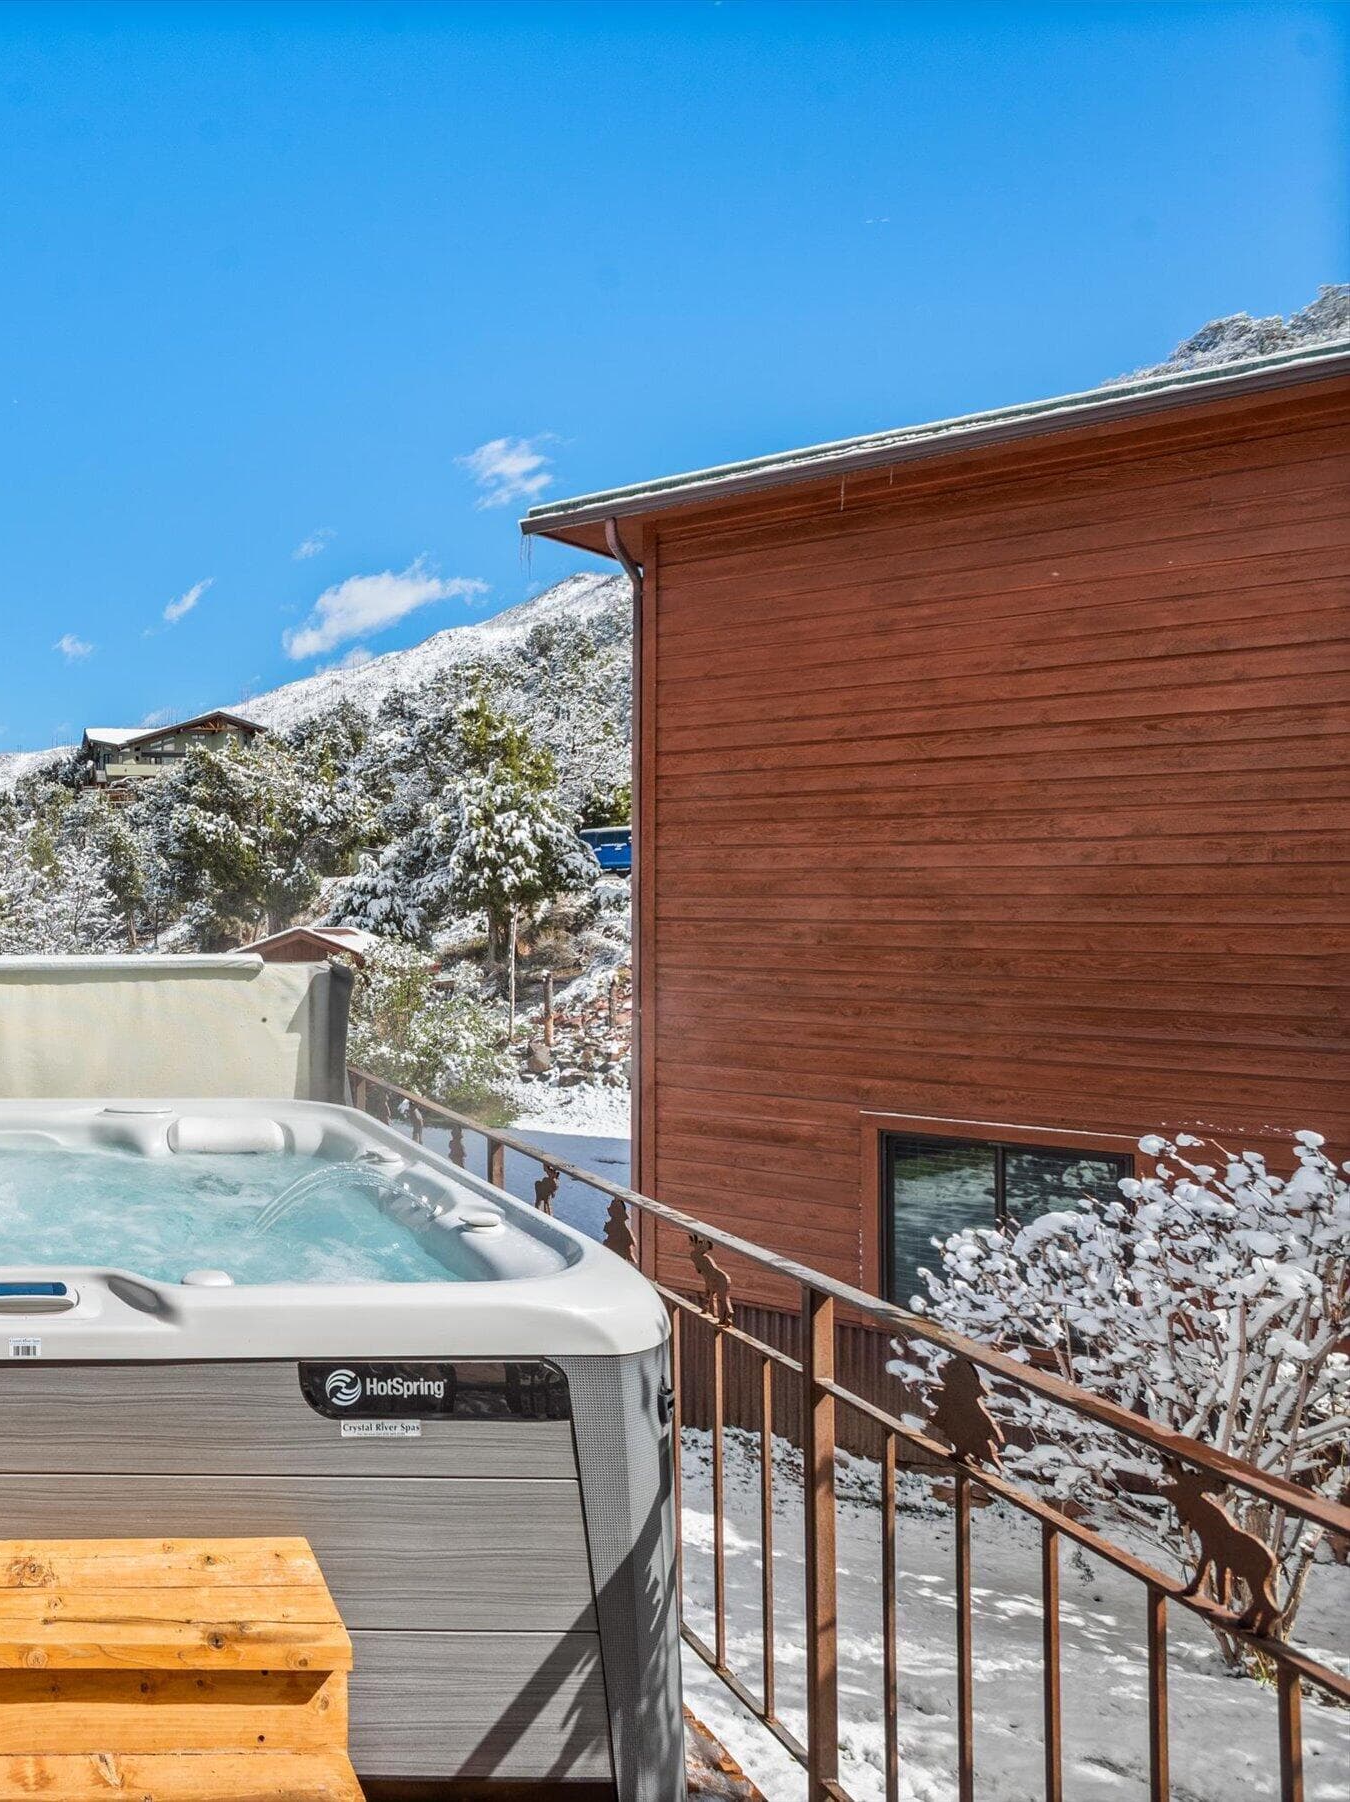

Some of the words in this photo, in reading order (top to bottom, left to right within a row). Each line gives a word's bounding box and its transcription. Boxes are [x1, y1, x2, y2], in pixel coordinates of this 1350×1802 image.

[366, 1377, 445, 1399] HotSpring
[342, 1423, 373, 1433] Crystal
[375, 1421, 397, 1432] River
[400, 1422, 420, 1433] Spas
